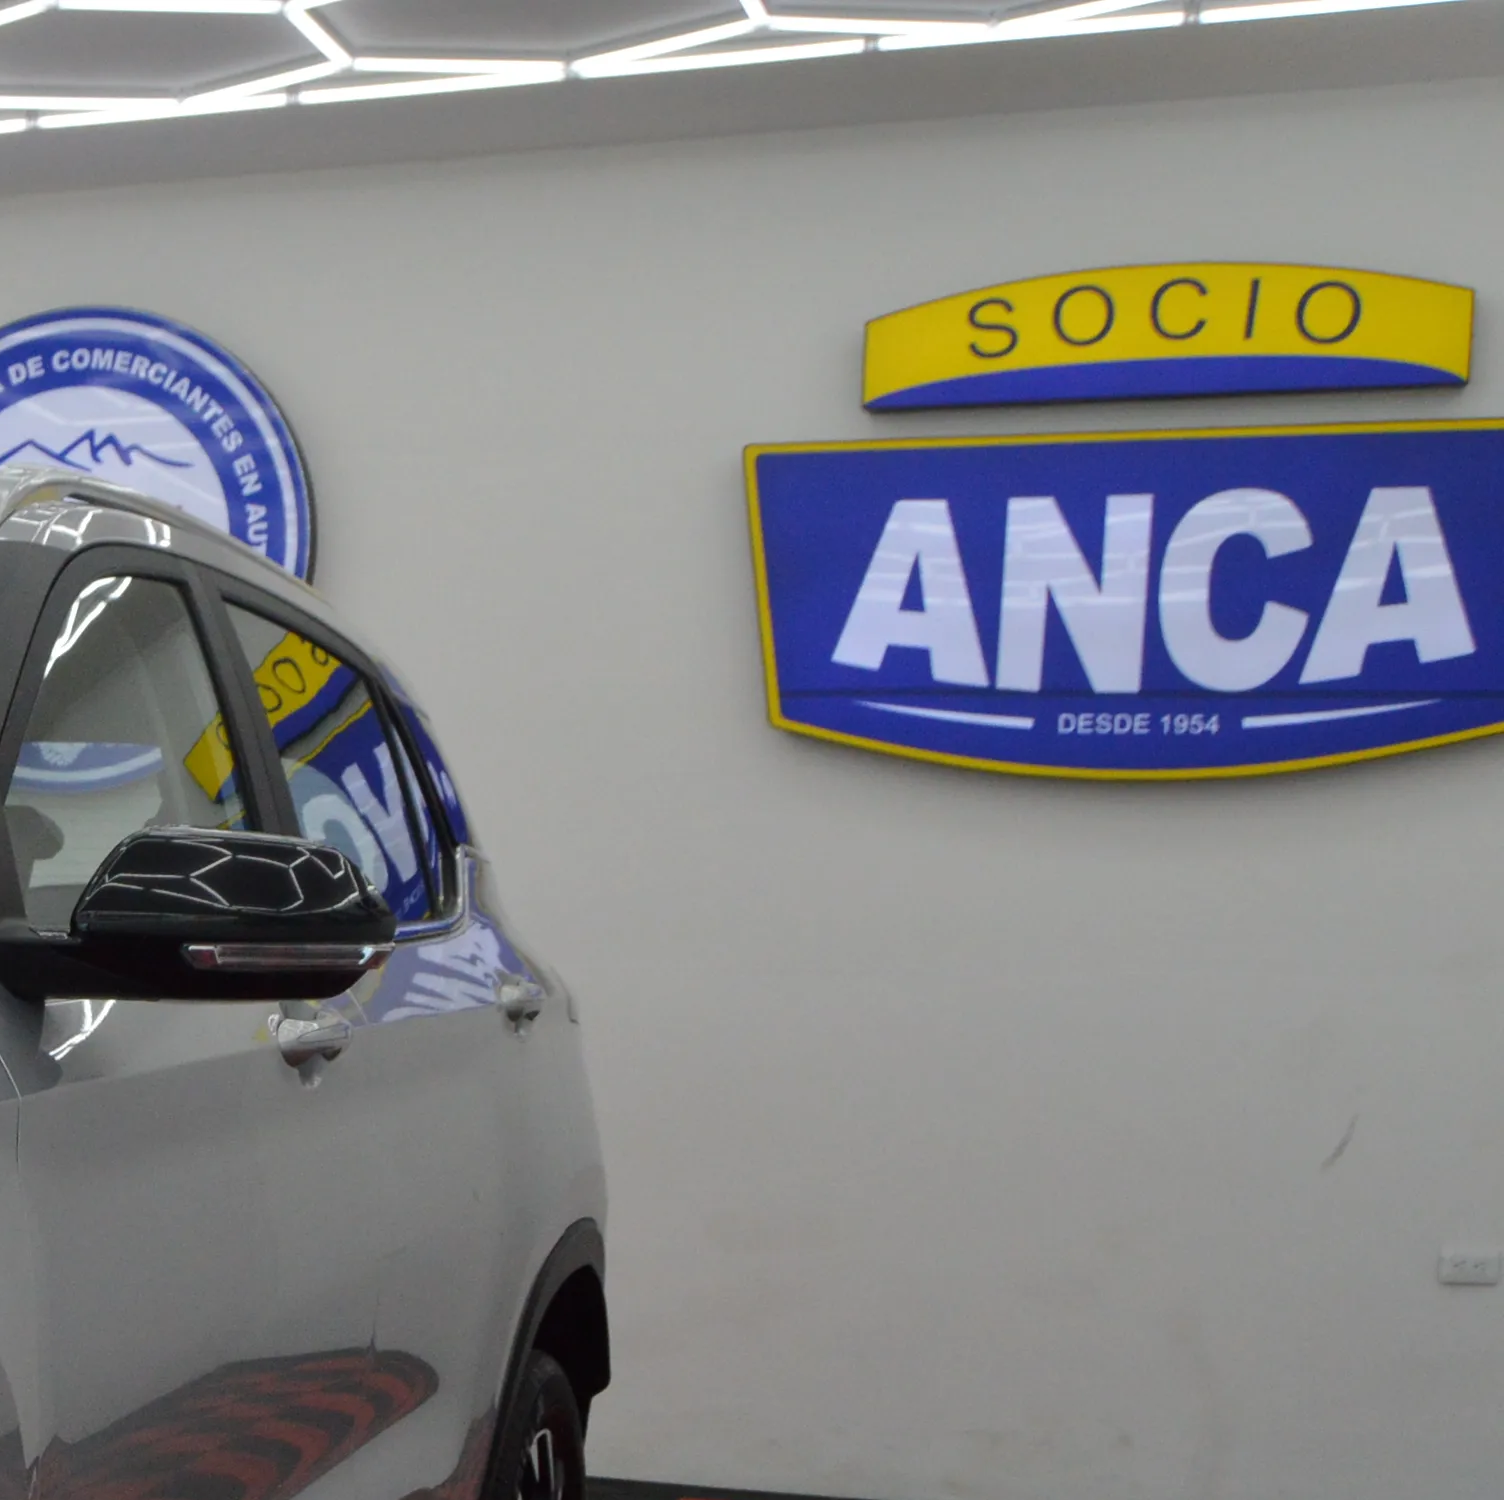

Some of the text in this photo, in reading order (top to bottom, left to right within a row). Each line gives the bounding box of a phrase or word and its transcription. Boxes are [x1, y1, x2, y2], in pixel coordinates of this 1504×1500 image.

[967, 276, 1364, 358] SOCIO
[7, 355, 46, 387] DE
[51, 347, 243, 453] COMERCIANTES
[231, 452, 263, 497] EN
[830, 485, 1477, 695] ANCA
[1056, 711, 1221, 736] DESDE 1954
